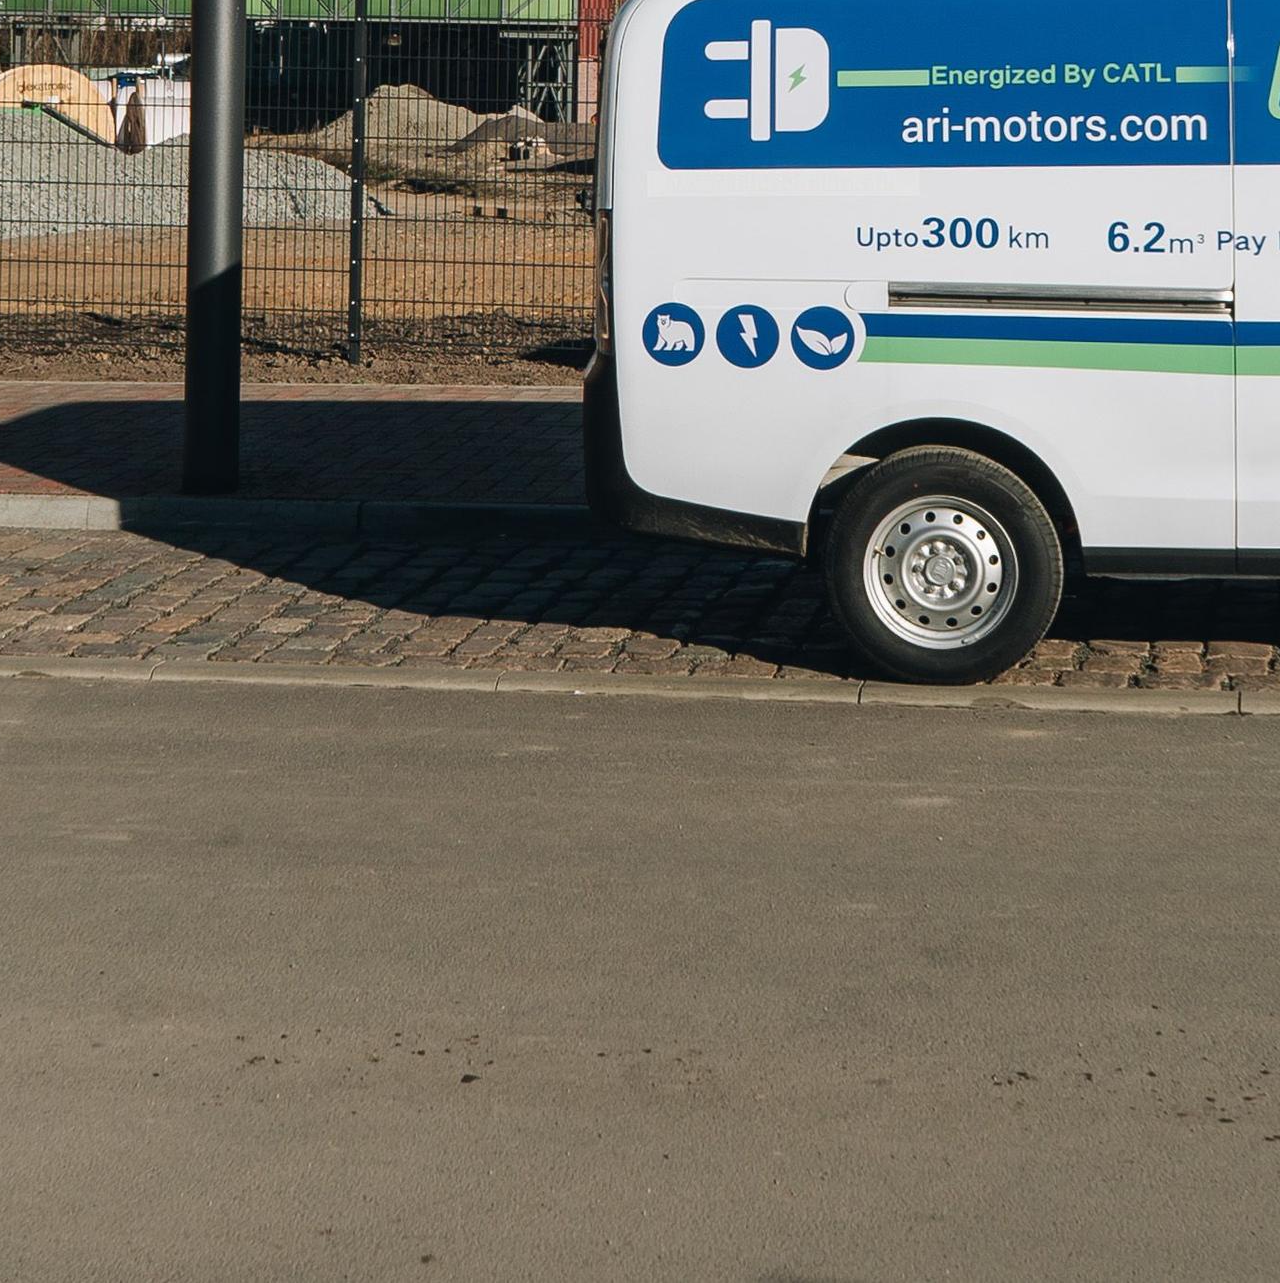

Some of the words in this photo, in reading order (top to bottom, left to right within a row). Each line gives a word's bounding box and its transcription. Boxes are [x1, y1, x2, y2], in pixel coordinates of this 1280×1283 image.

[932, 64, 1056, 89] Energized
[1064, 63, 1096, 88] By
[1102, 62, 1171, 83] CATL
[901, 106, 1208, 143] ari-motors.com
[1008, 225, 1049, 249] km
[1216, 230, 1267, 256] Pay
